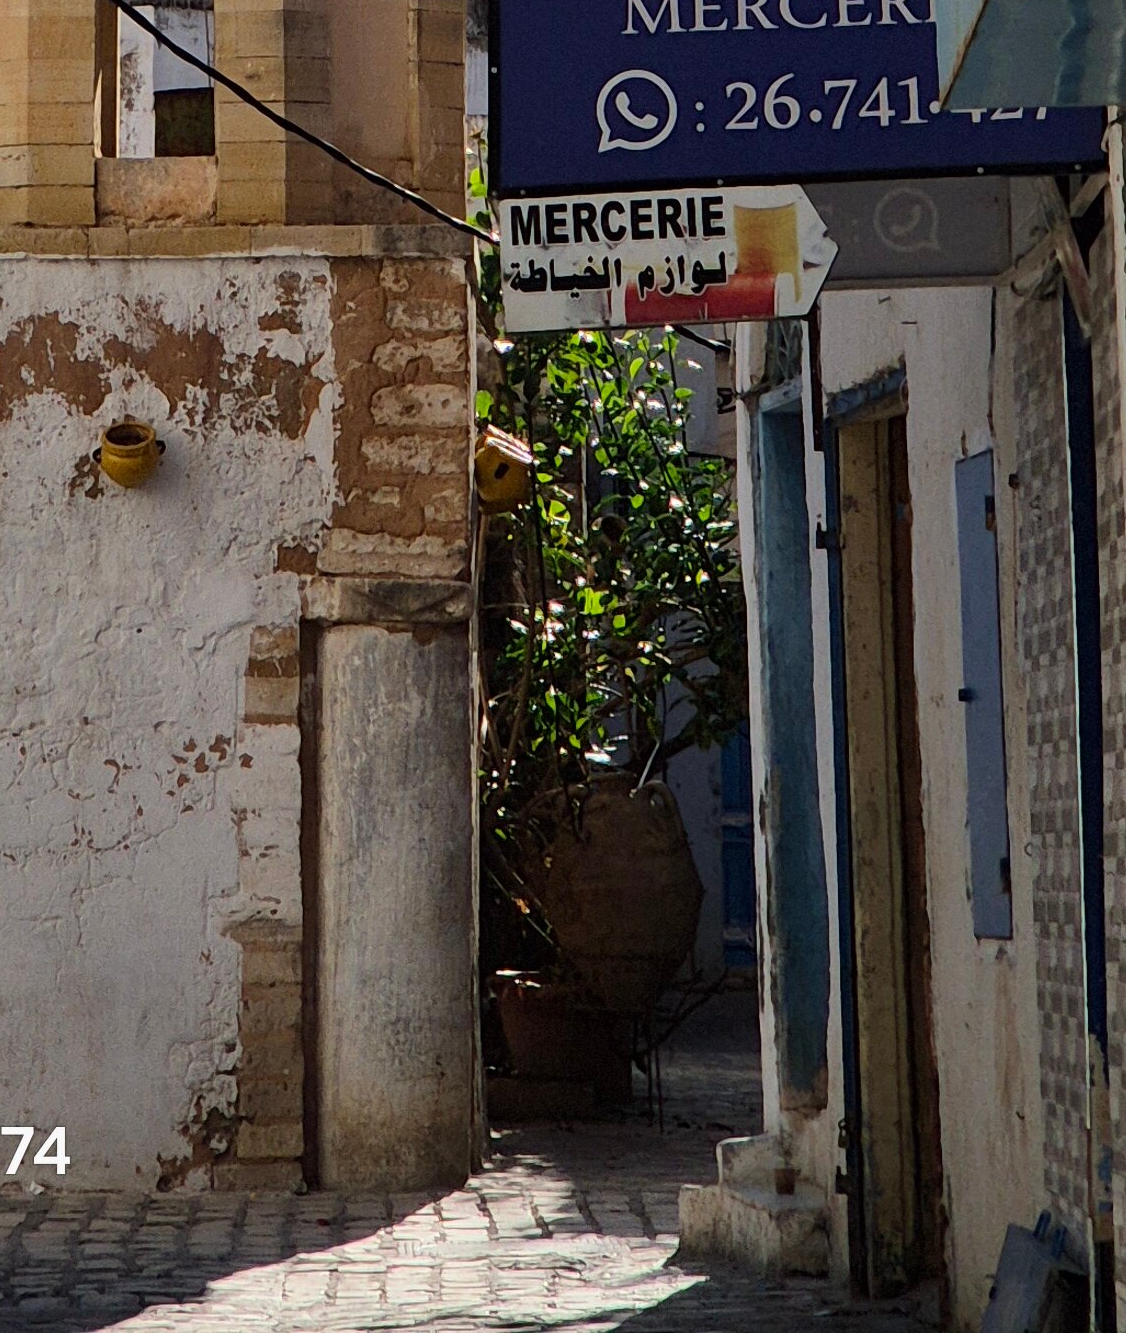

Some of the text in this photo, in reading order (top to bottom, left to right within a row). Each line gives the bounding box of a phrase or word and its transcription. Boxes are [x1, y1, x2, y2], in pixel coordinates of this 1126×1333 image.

[509, 195, 727, 247] MERCERIE
[509, 250, 727, 300] لوازم الخياطة
